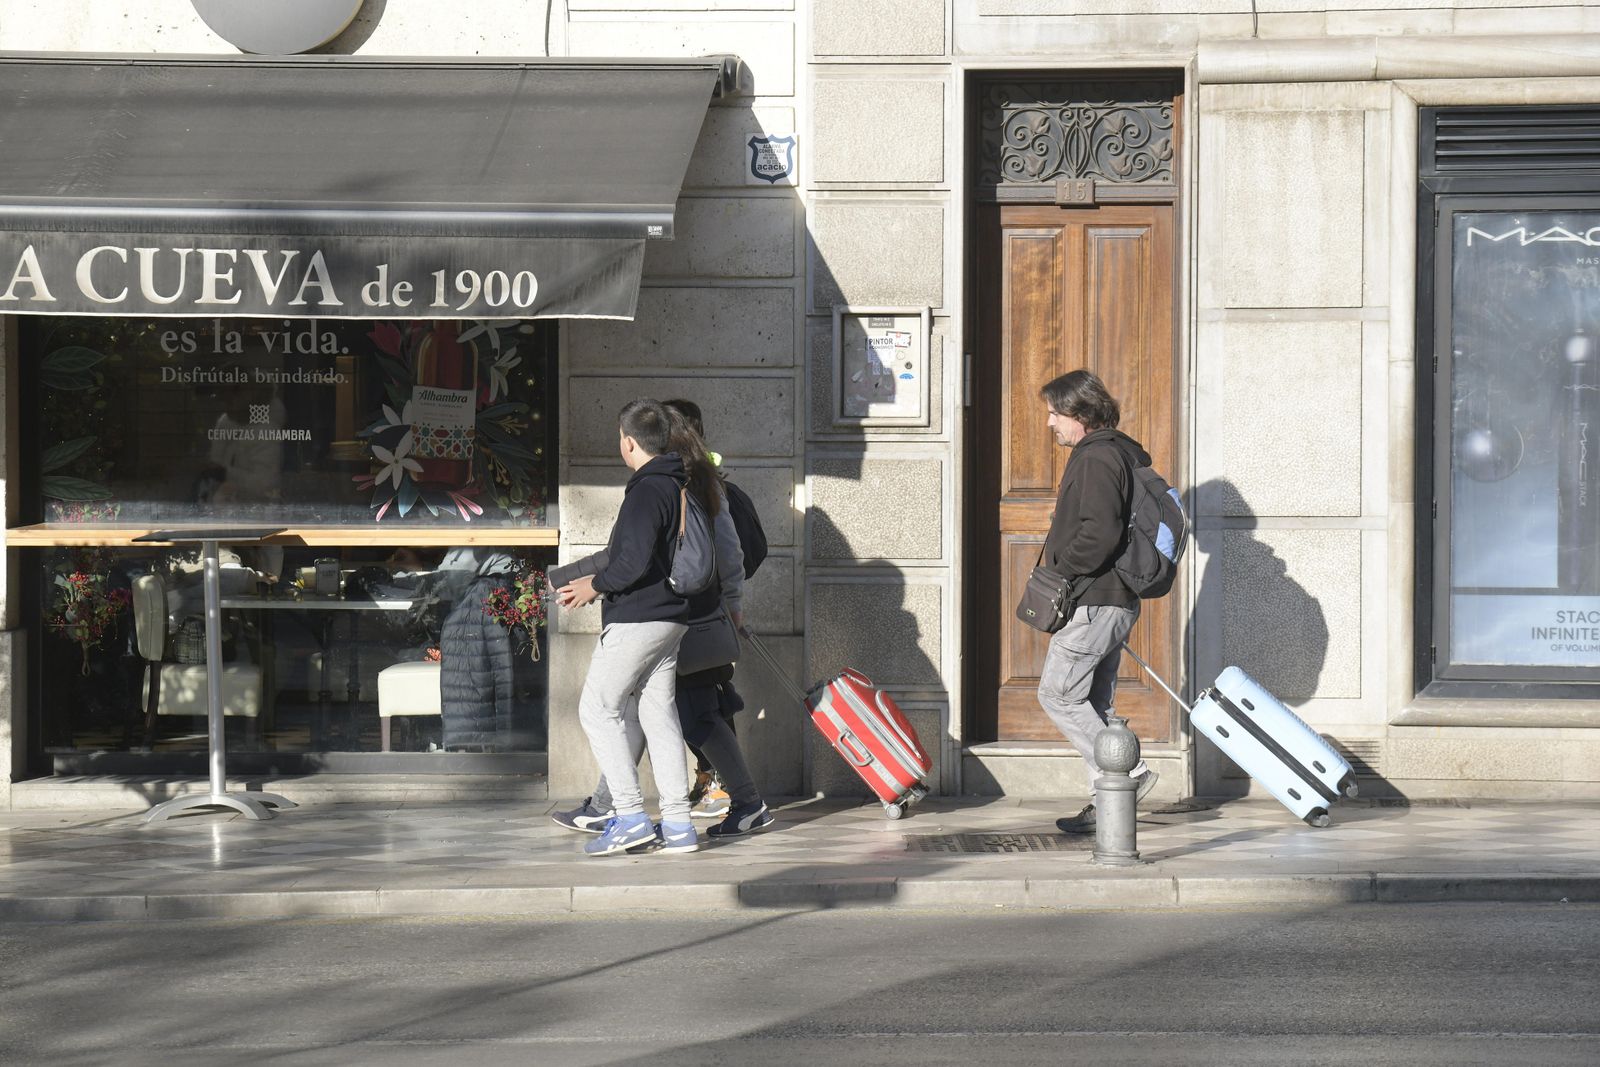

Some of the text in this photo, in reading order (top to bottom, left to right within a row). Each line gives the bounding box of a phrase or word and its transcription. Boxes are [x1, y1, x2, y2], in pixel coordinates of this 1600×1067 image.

[1063, 182, 1087, 200] 15
[1467, 226, 1600, 246] MA
[75, 245, 344, 307] CUEVA
[361, 263, 415, 308] de
[429, 269, 539, 311] 1900
[160, 318, 350, 355] es la vida.
[160, 367, 350, 384] Disfrútala brindando.
[418, 389, 468, 404] Alhambra
[207, 429, 312, 441] CERVEZAS ALHAMBRA
[1531, 627, 1600, 641] INFINITE
[1550, 643, 1600, 653] OF VOLUM
